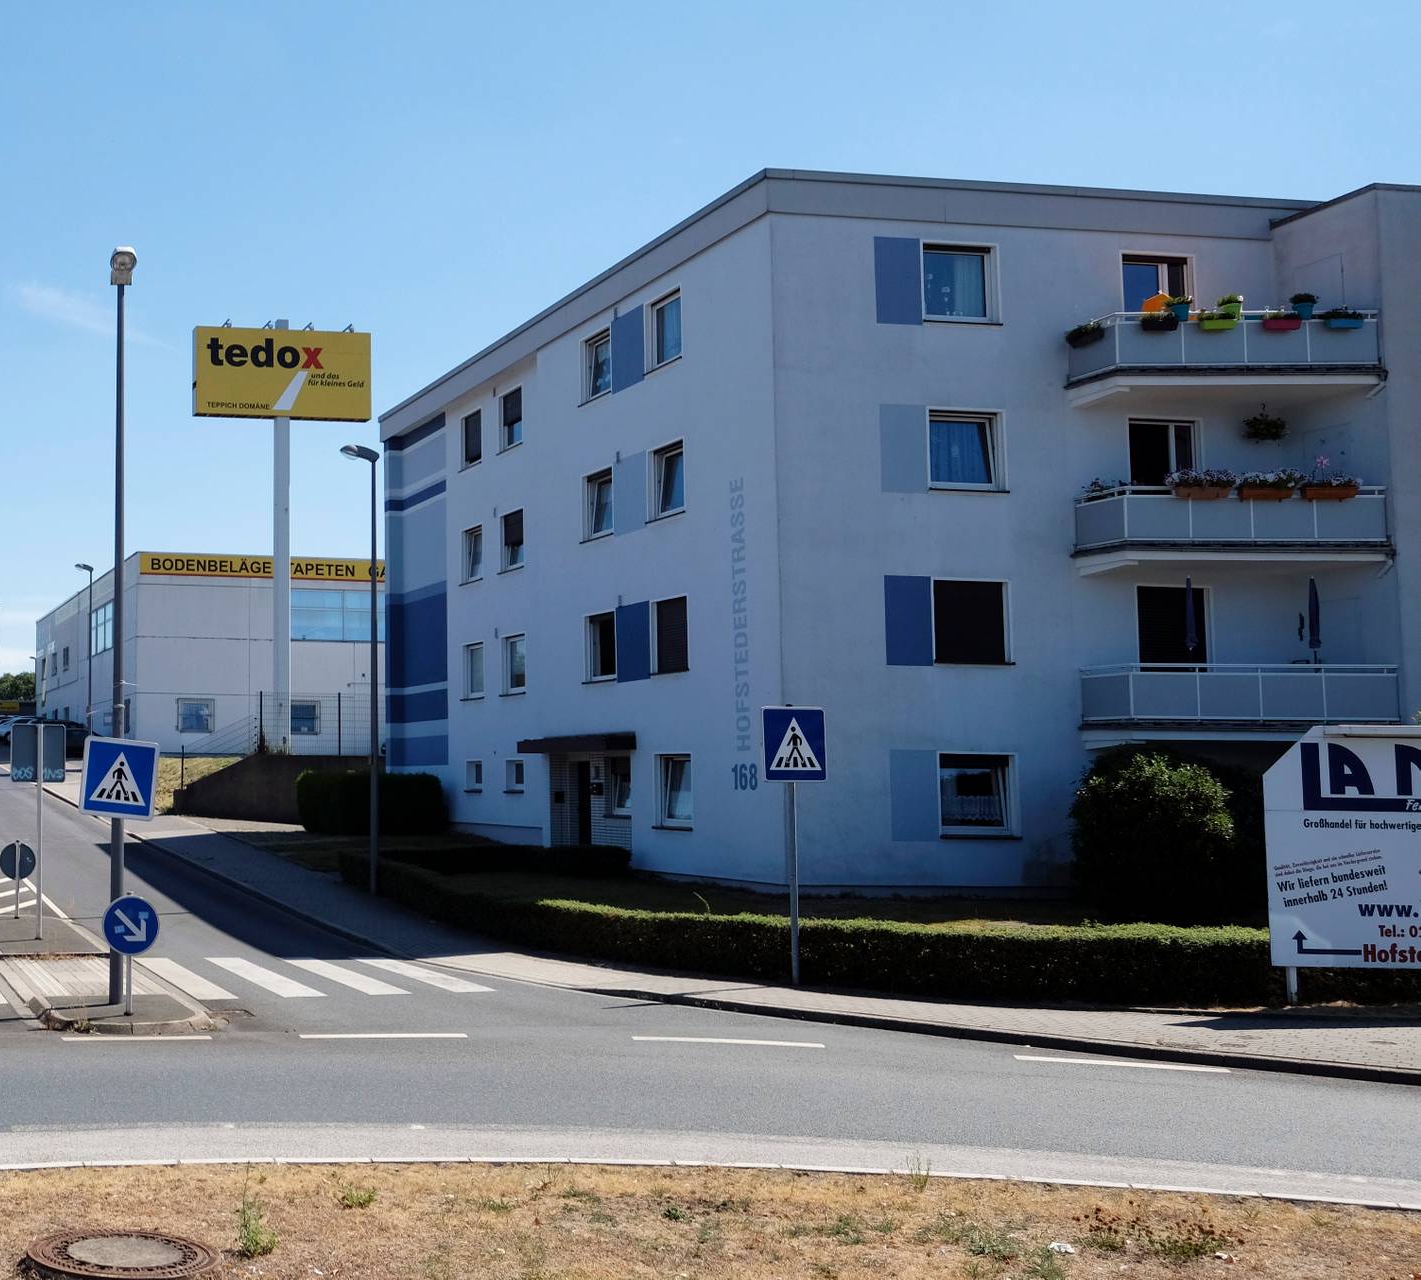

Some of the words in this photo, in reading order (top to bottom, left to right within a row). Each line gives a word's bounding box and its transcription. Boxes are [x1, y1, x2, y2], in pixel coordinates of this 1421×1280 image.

[207, 337, 324, 369] tedox
[308, 380, 318, 388] für
[320, 380, 346, 388] kleines
[347, 380, 364, 388] Geld
[311, 372, 325, 380] und
[207, 401, 237, 410] TEPPICH
[150, 557, 272, 575] BODENBELÄGE
[730, 477, 751, 752] HOFSTEDERSTRASSE
[731, 763, 757, 790] 168
[1303, 819, 1352, 829] Großhandel
[1354, 819, 1367, 829] für
[1277, 880, 1296, 893] Wir
[1297, 876, 1329, 889] liefern
[1331, 865, 1386, 883] bundesweit
[1283, 891, 1328, 908] innerhalb
[1330, 888, 1344, 900] 24
[1346, 880, 1388, 897] Stunden!
[1358, 904, 1419, 918] www.
[1379, 925, 1405, 937] Tel.:
